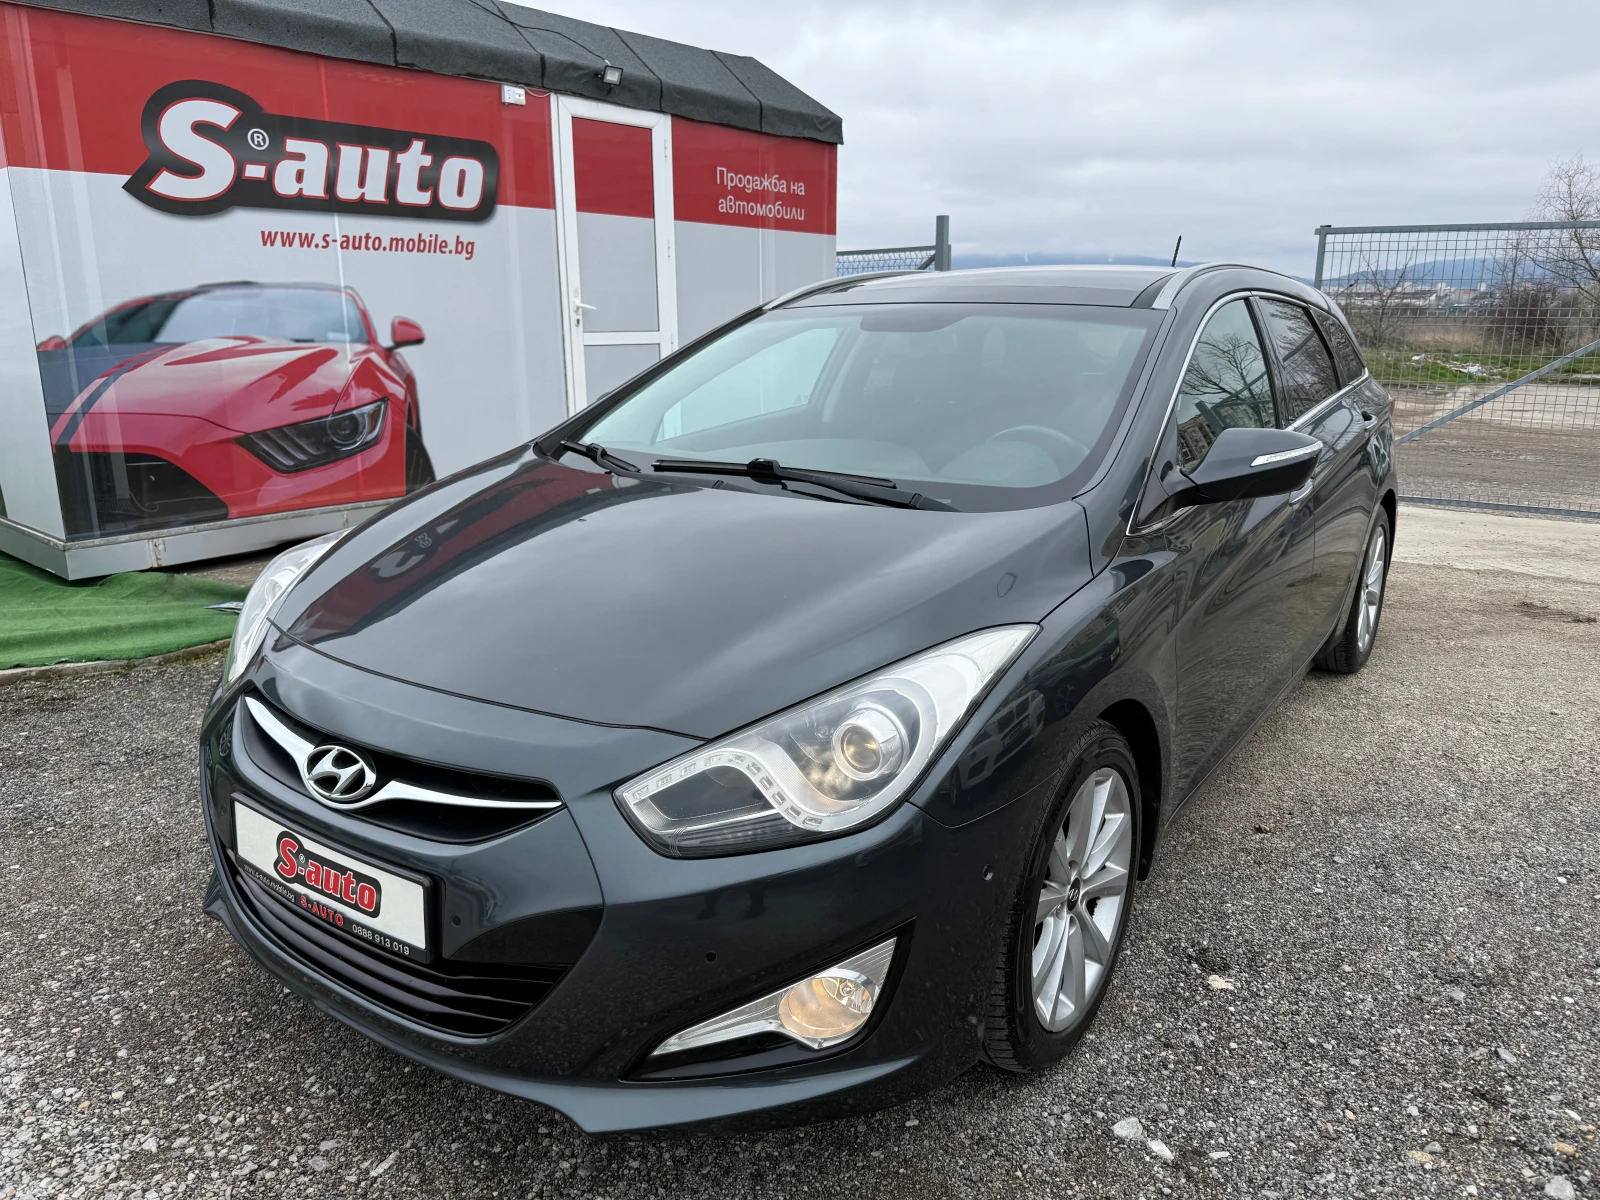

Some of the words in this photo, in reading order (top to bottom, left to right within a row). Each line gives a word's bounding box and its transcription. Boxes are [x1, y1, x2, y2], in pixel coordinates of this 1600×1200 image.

[716, 166, 787, 193] Продажба
[790, 181, 805, 196] на
[718, 195, 805, 221] автомобили
[260, 229, 475, 260] www.s-auto.mobile.bg
[300, 895, 344, 927] S-AUTO
[352, 924, 373, 940] 0888
[374, 934, 391, 948] 913
[393, 942, 410, 956] 019
